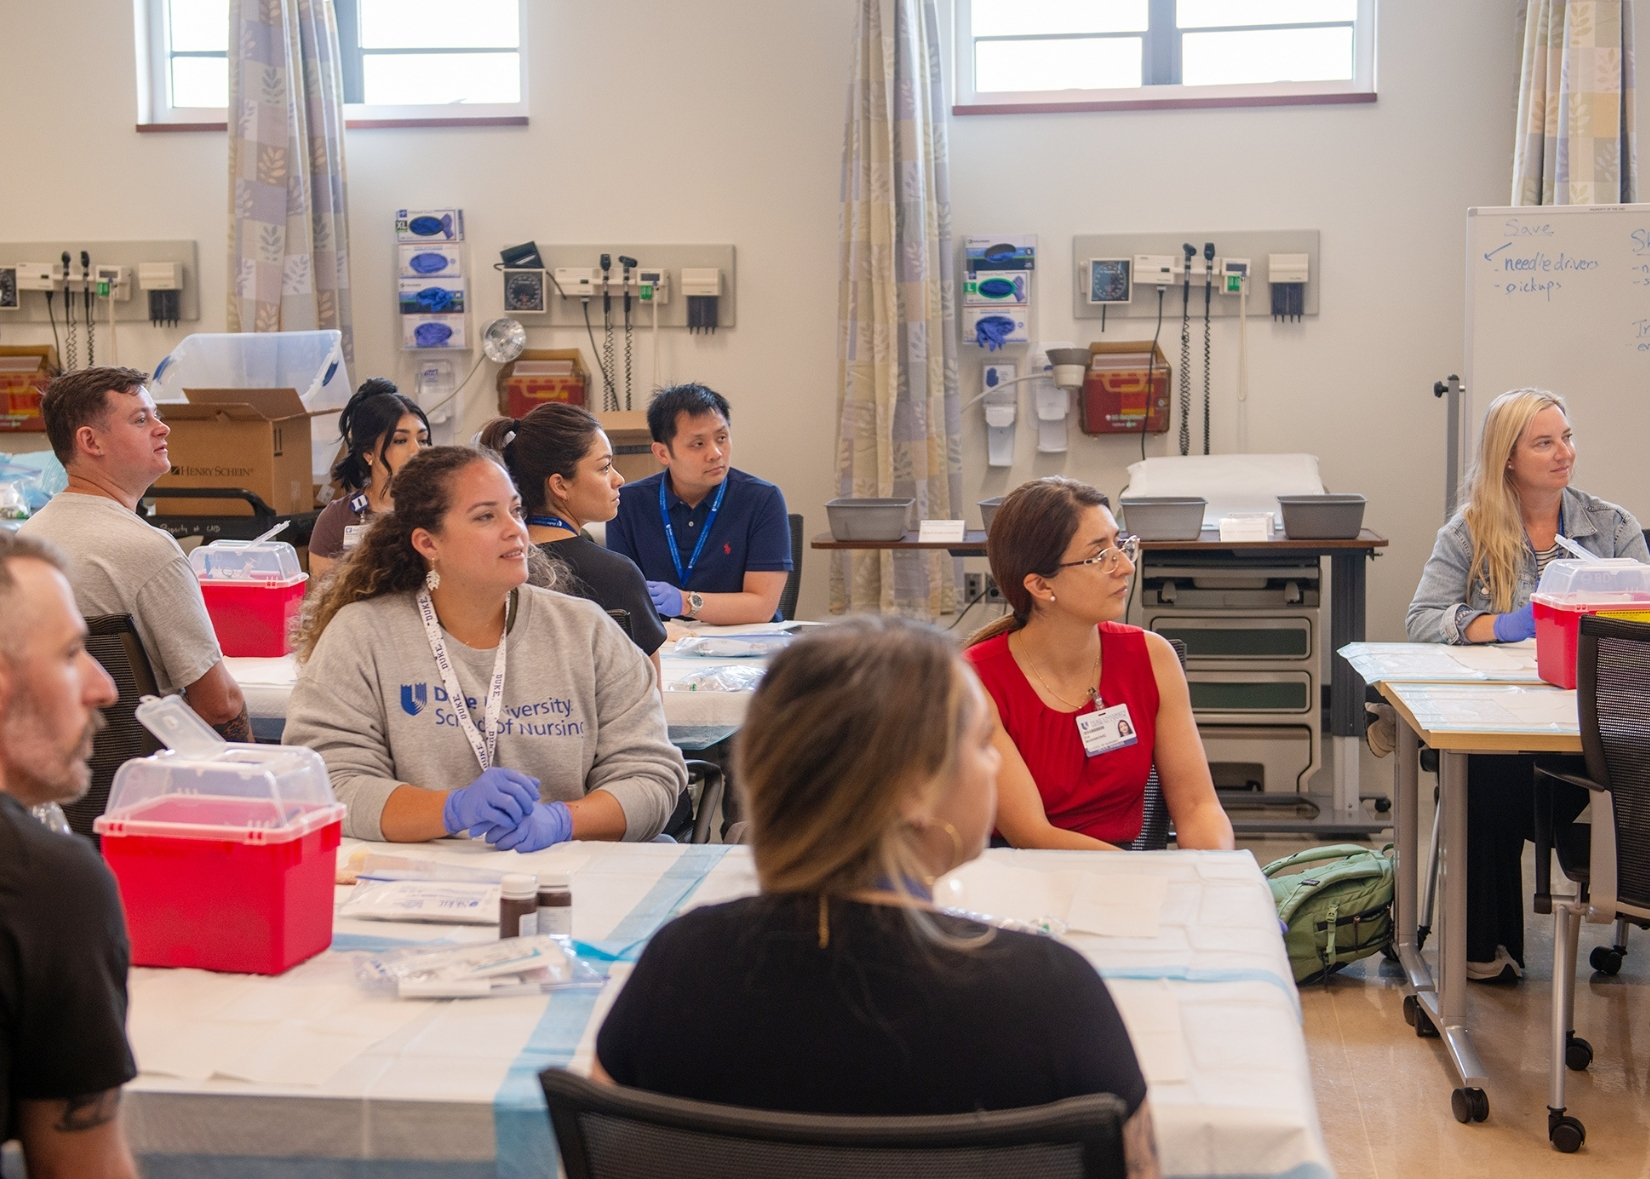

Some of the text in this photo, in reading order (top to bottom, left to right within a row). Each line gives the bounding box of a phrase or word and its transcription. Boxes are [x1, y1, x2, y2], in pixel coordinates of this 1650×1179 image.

[396, 220, 407, 230] XL
[1504, 218, 1554, 237] Save
[1504, 252, 1599, 272] needle drivers
[180, 466, 250, 477] HENRY SCHEIN
[420, 596, 434, 622] DUKE
[435, 643, 448, 670] DUKE
[493, 674, 503, 698] DUKE
[452, 693, 467, 720] DUKE
